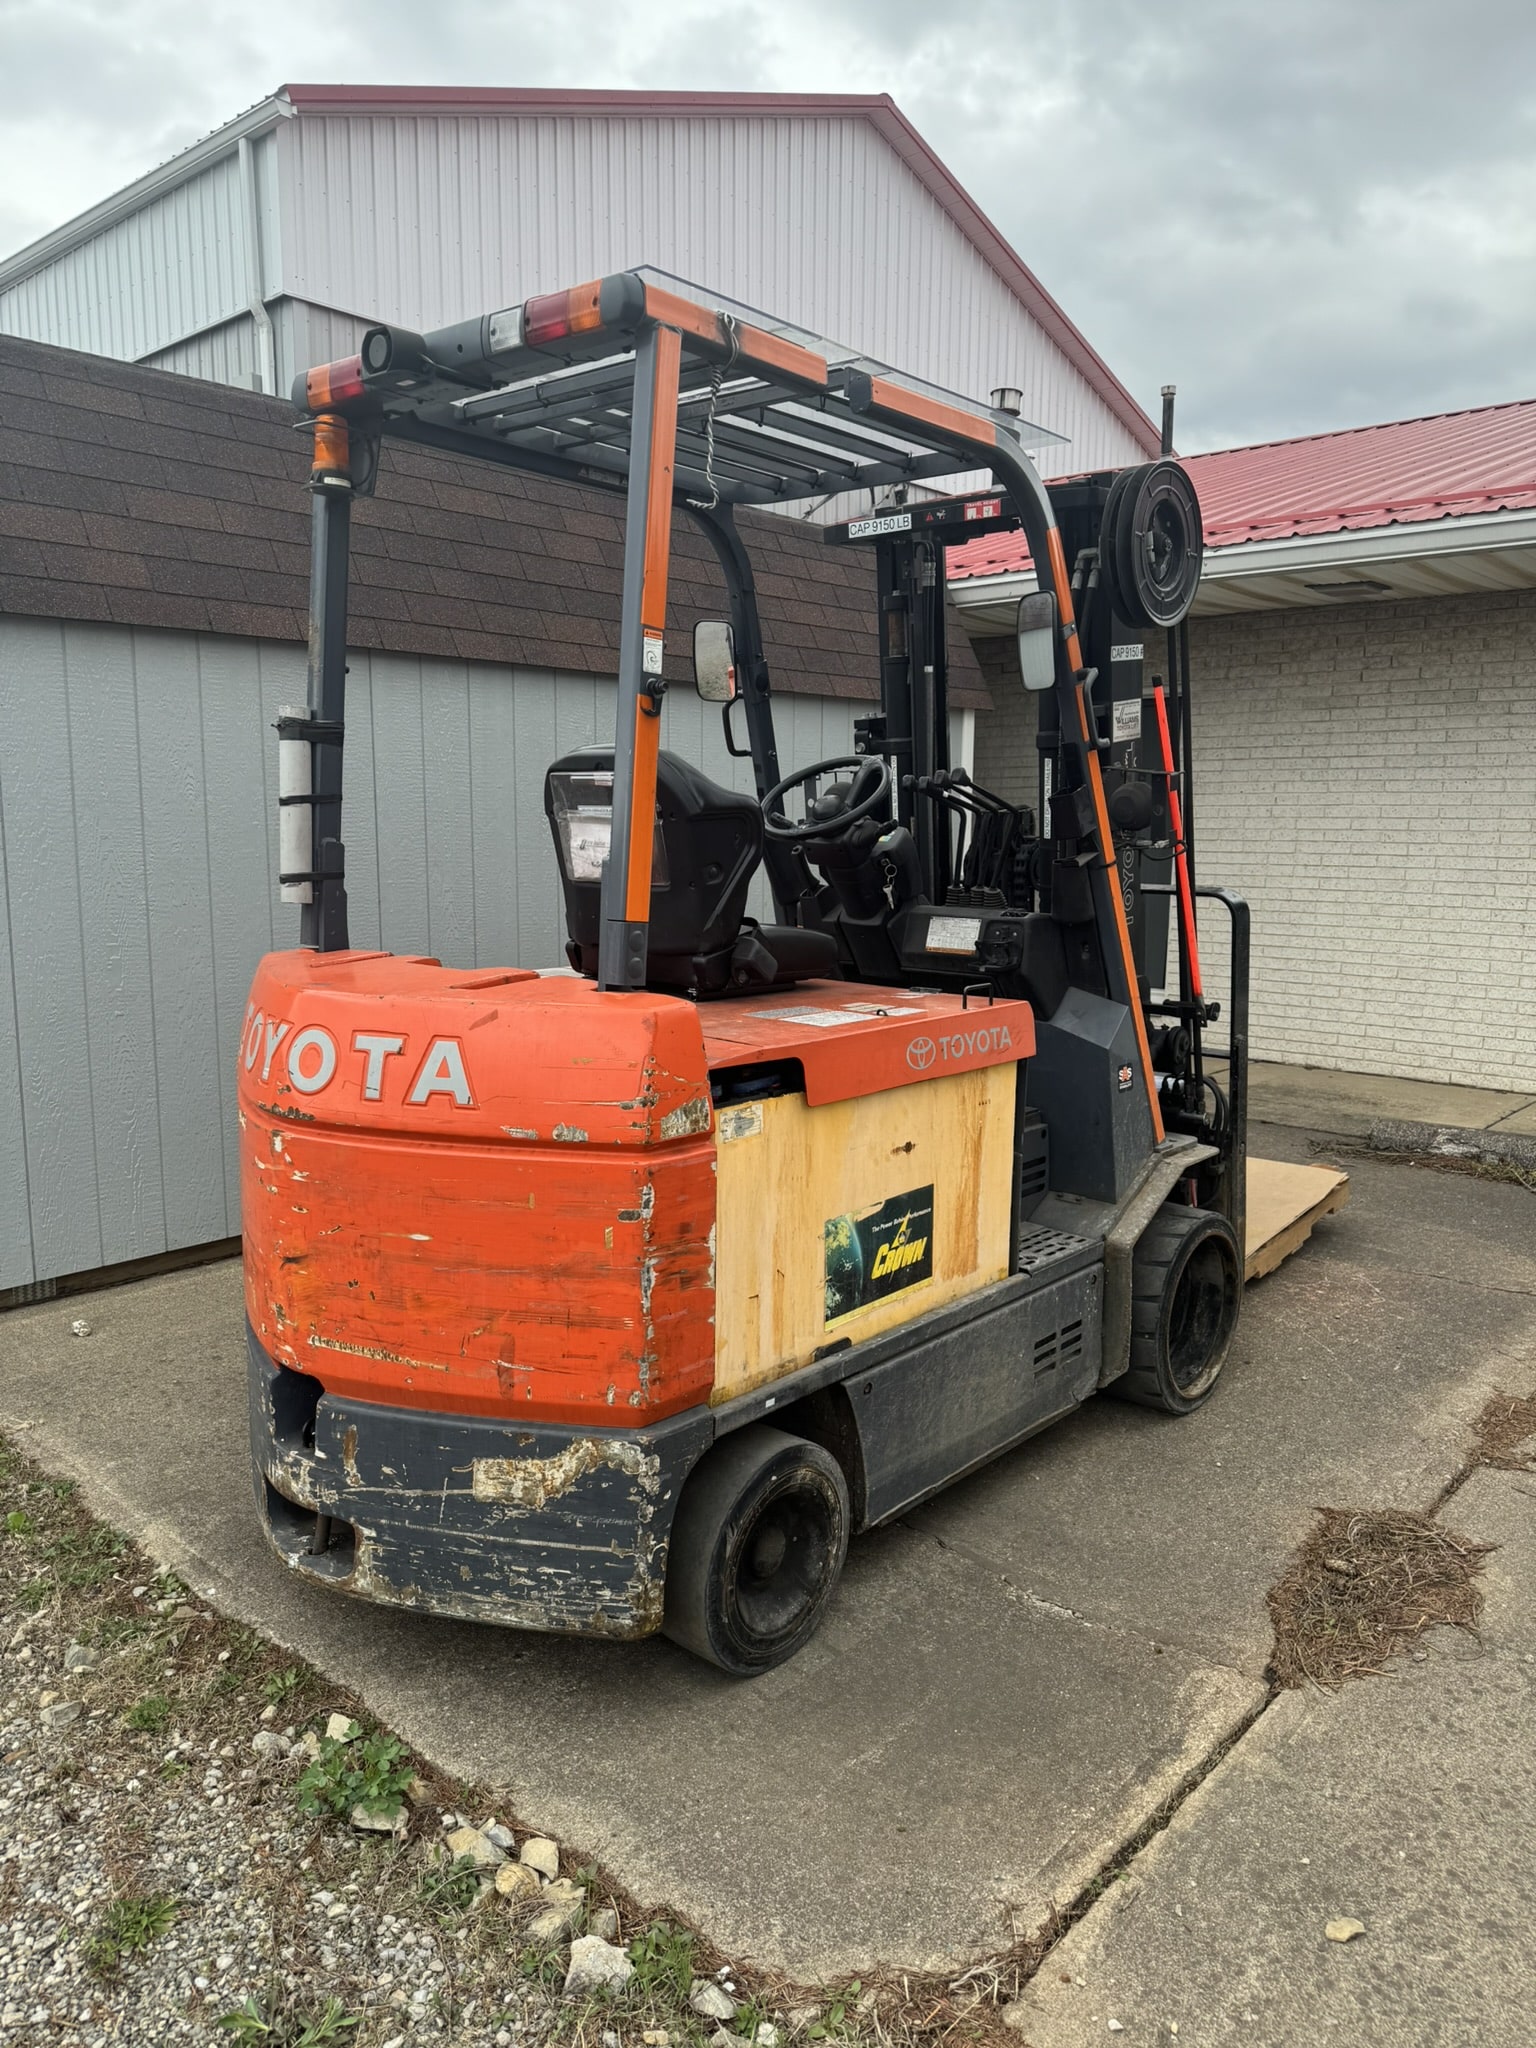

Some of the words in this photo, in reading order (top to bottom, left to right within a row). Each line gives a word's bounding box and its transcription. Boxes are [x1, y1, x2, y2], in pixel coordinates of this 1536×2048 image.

[850, 522, 870, 536] CAP
[872, 518, 895, 532] 9150
[897, 515, 910, 528] LB
[1112, 647, 1123, 659] CAP
[1125, 646, 1139, 658] 9150
[939, 1025, 1012, 1061] TOYOTA
